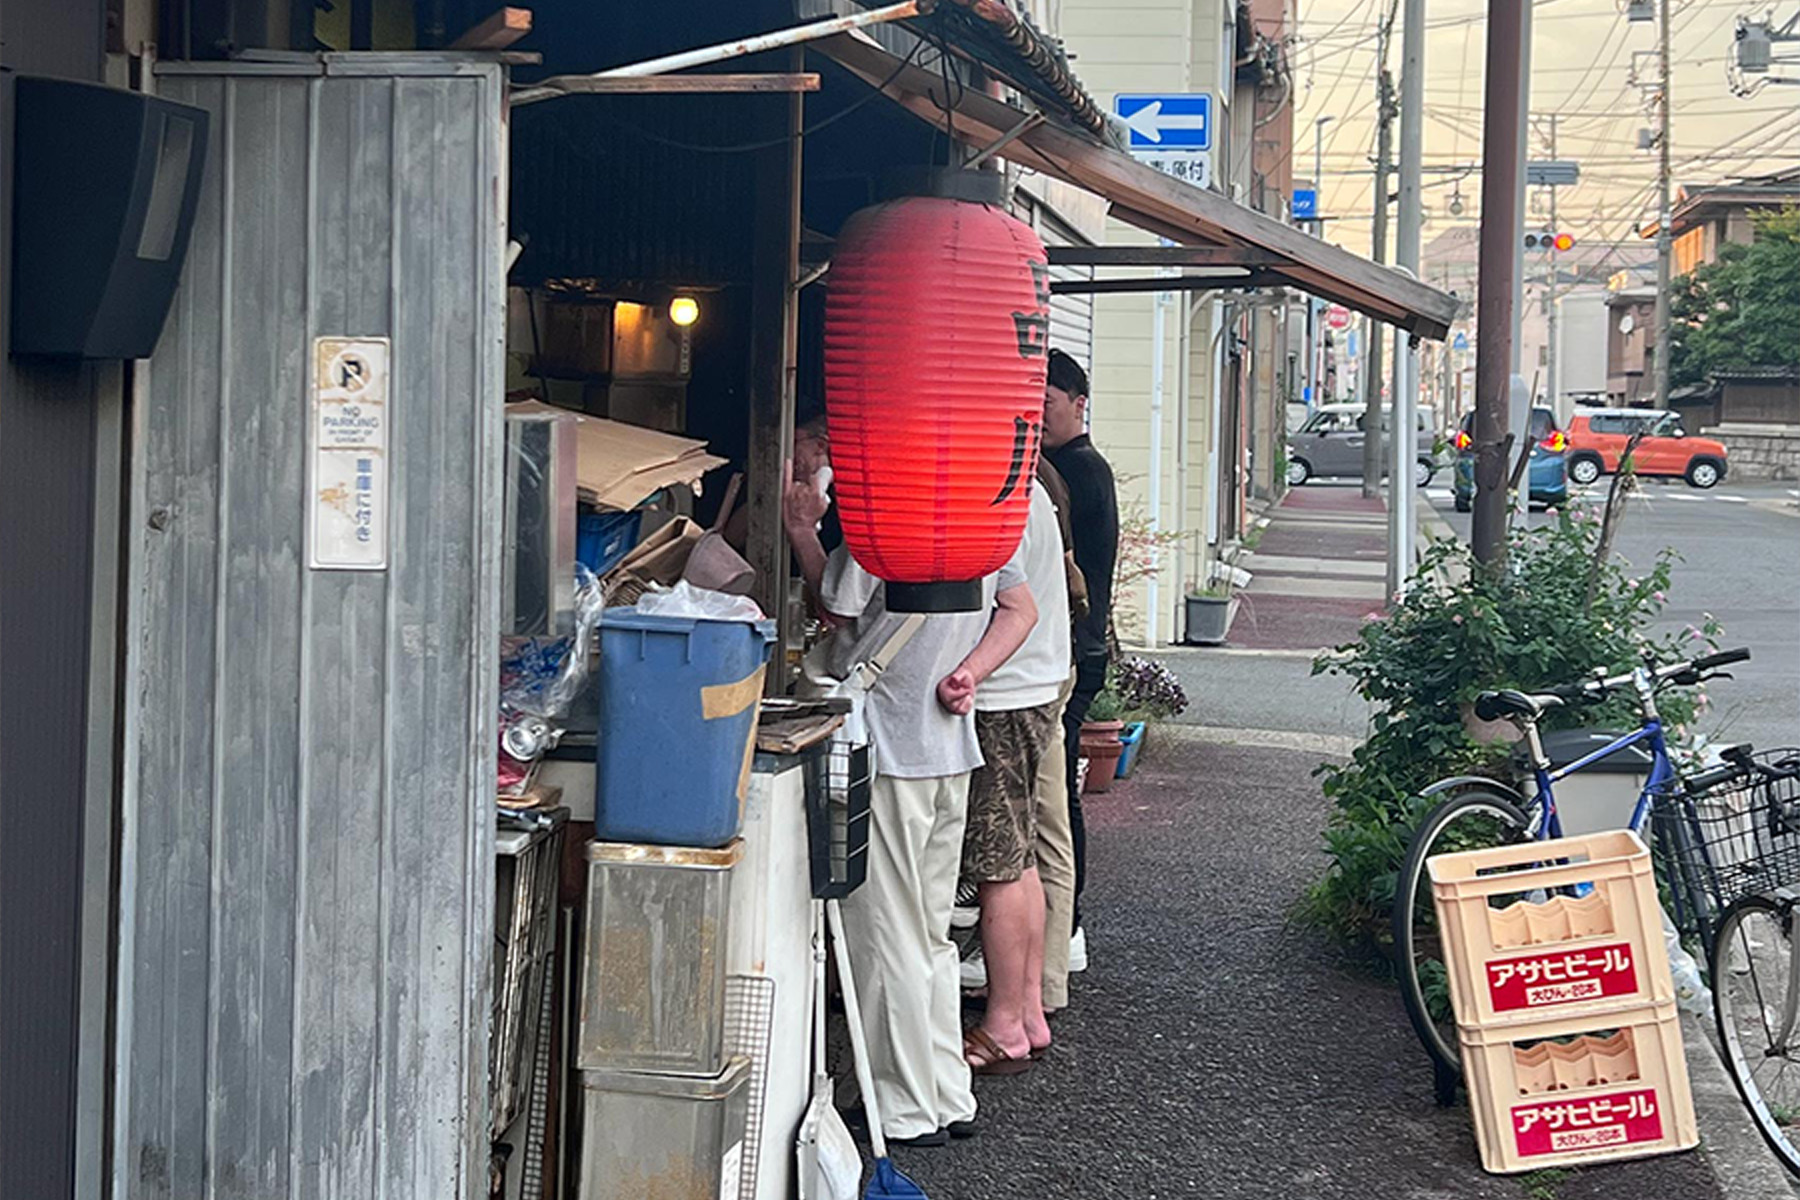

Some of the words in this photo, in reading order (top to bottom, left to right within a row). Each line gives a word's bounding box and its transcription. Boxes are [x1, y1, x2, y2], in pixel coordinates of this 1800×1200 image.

[323, 417, 379, 428] PARKING
[342, 406, 361, 417] NO
[1490, 949, 1630, 987] アサヒビール
[1513, 1094, 1655, 1134] アサヒビール
